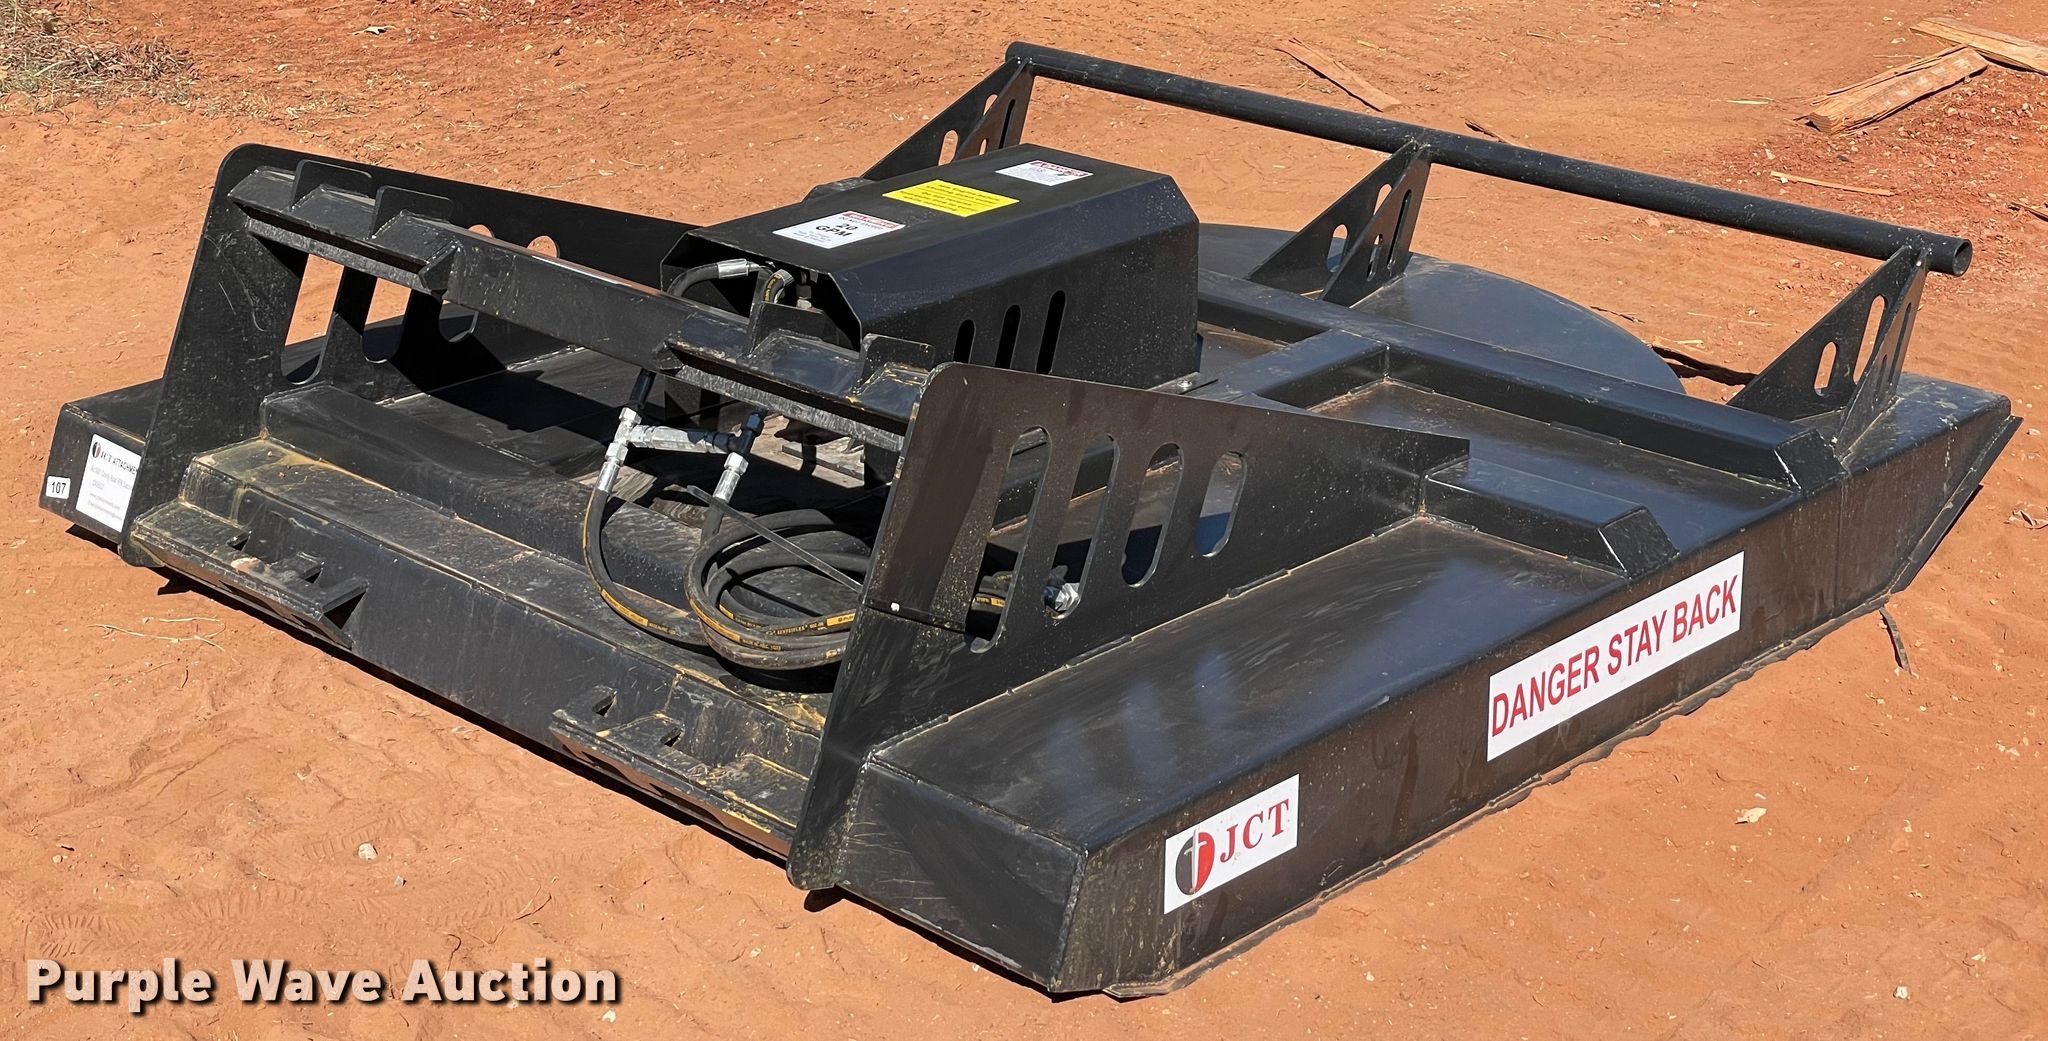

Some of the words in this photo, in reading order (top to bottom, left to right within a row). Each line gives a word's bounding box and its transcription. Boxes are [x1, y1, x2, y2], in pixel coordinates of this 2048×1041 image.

[816, 226, 853, 237] GPM
[836, 223, 858, 231] 20
[51, 482, 66, 495] 107
[1492, 645, 1600, 737] DANGER
[1607, 610, 1666, 676] STAY
[1672, 575, 1738, 643] BACK
[1220, 799, 1289, 863] JCT
